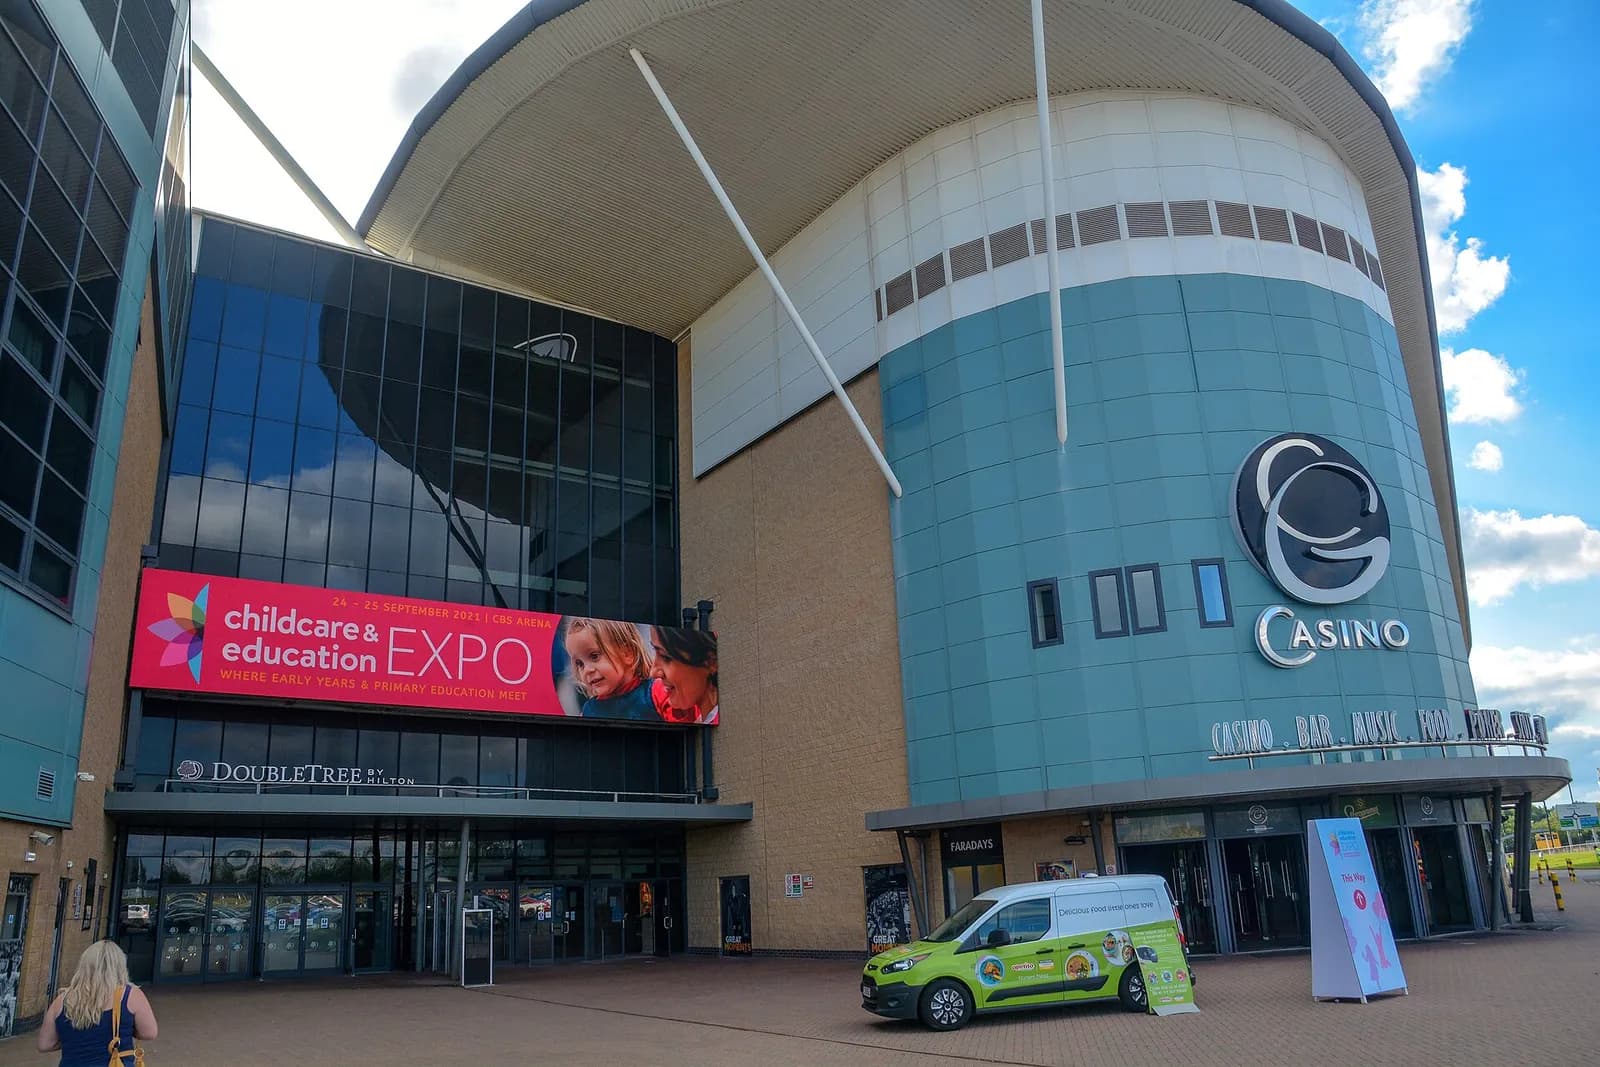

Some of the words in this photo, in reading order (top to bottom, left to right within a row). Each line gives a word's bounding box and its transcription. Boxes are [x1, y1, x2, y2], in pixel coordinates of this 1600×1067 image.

[224, 603, 360, 641] childcare
[362, 623, 380, 643] &
[332, 596, 347, 608] 24
[364, 600, 379, 611] 25
[383, 602, 450, 618] SEPTEMBER
[453, 610, 481, 622] 2021
[492, 614, 513, 625] CBS
[516, 617, 552, 629] ARENA
[1254, 604, 1411, 669] CASINO
[222, 636, 377, 673] education
[387, 626, 533, 685] EXPO
[220, 668, 267, 683] WHERE
[271, 673, 313, 686] EARLY
[316, 676, 356, 689] YEARS
[360, 679, 370, 690] &
[374, 680, 427, 695] PRIMARY
[430, 685, 495, 699] EDUCATION
[498, 690, 528, 701] MEET
[1211, 718, 1274, 755] CASINO
[1295, 714, 1334, 749] BAR
[1351, 710, 1402, 745] MUSIC
[1418, 709, 1452, 742] FOOD
[366, 776, 416, 785] HILTON
[367, 768, 384, 776] BY
[950, 838, 994, 852] FARADAYS
[1341, 873, 1354, 883] This
[1058, 907, 1090, 917] Delicious
[873, 935, 897, 944] GREAT
